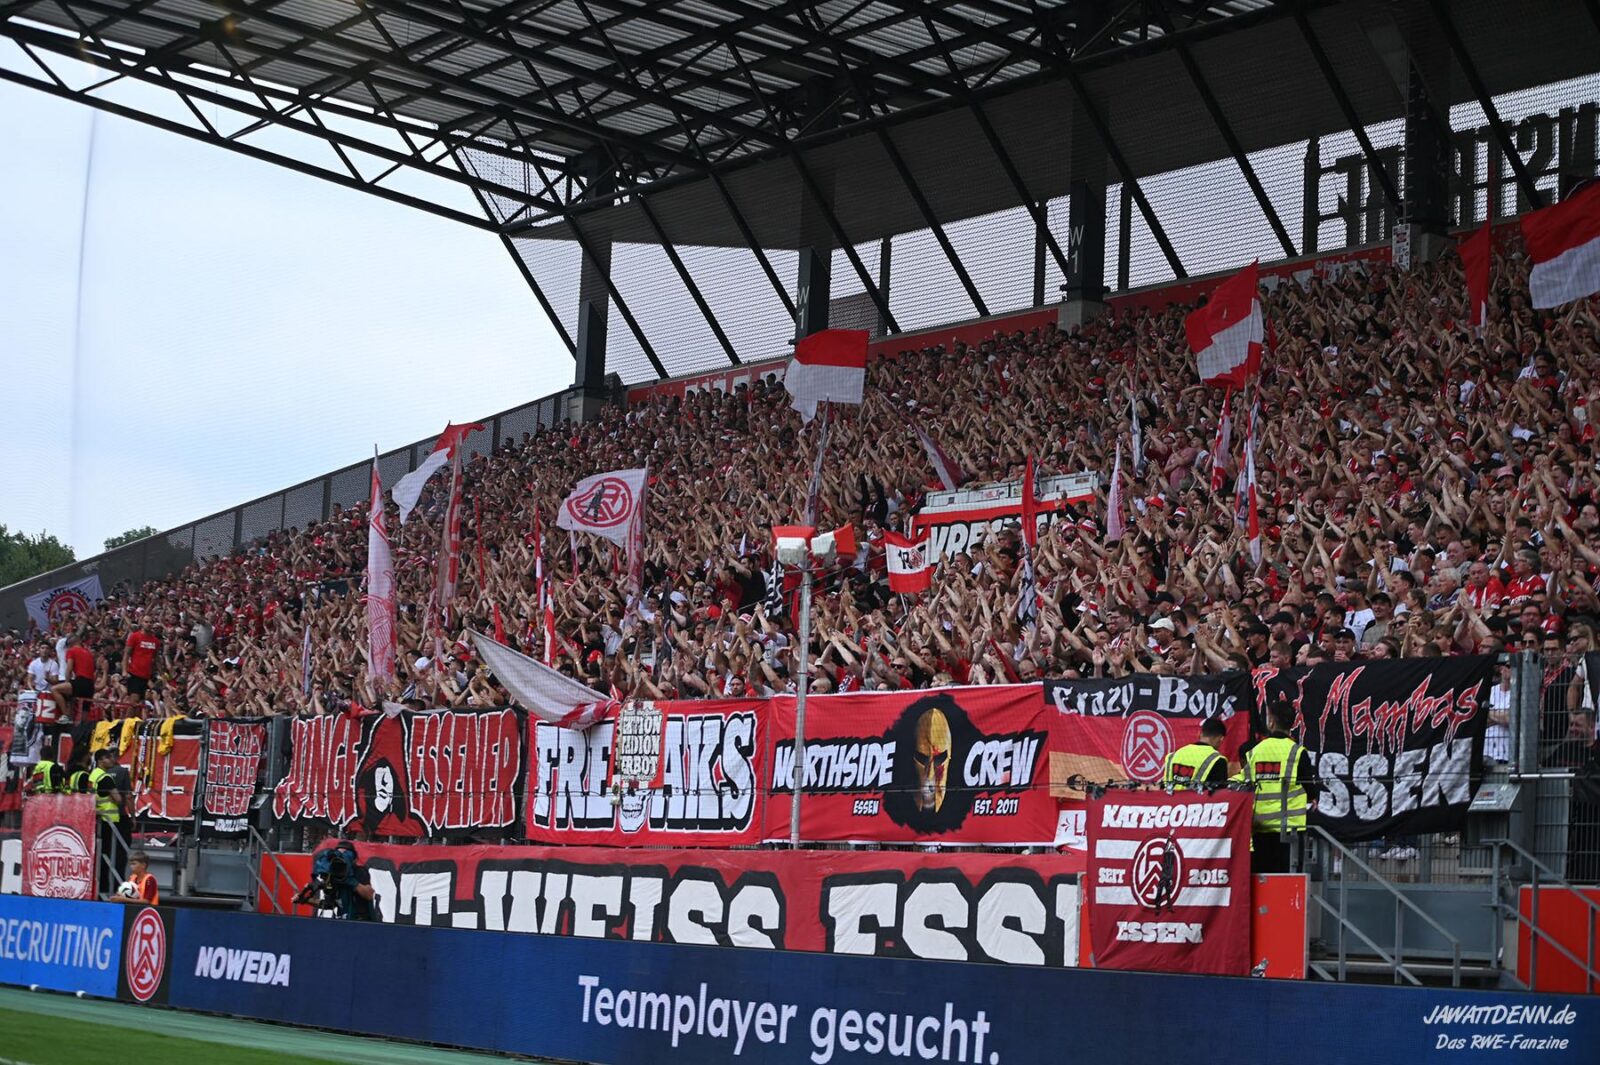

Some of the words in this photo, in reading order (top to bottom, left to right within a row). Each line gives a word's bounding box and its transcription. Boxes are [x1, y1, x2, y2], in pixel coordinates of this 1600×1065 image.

[1319, 665, 1484, 757] Mambas
[408, 708, 518, 830] ESSENER
[534, 710, 757, 832] FREAKS
[963, 736, 1039, 787] CREW
[1308, 737, 1473, 822] SSEN
[852, 800, 880, 815] ESSEN
[974, 800, 993, 814] EST.
[996, 799, 1018, 814] 2011
[1101, 803, 1229, 828] KATEGORIE
[1098, 867, 1126, 883] SEIT
[1188, 868, 1229, 885] 2015
[1115, 921, 1204, 944] ESSEN
[195, 946, 291, 987] NOWEDA
[578, 975, 798, 1055] Teamplayer
[810, 1002, 1000, 1065] gesucht.
